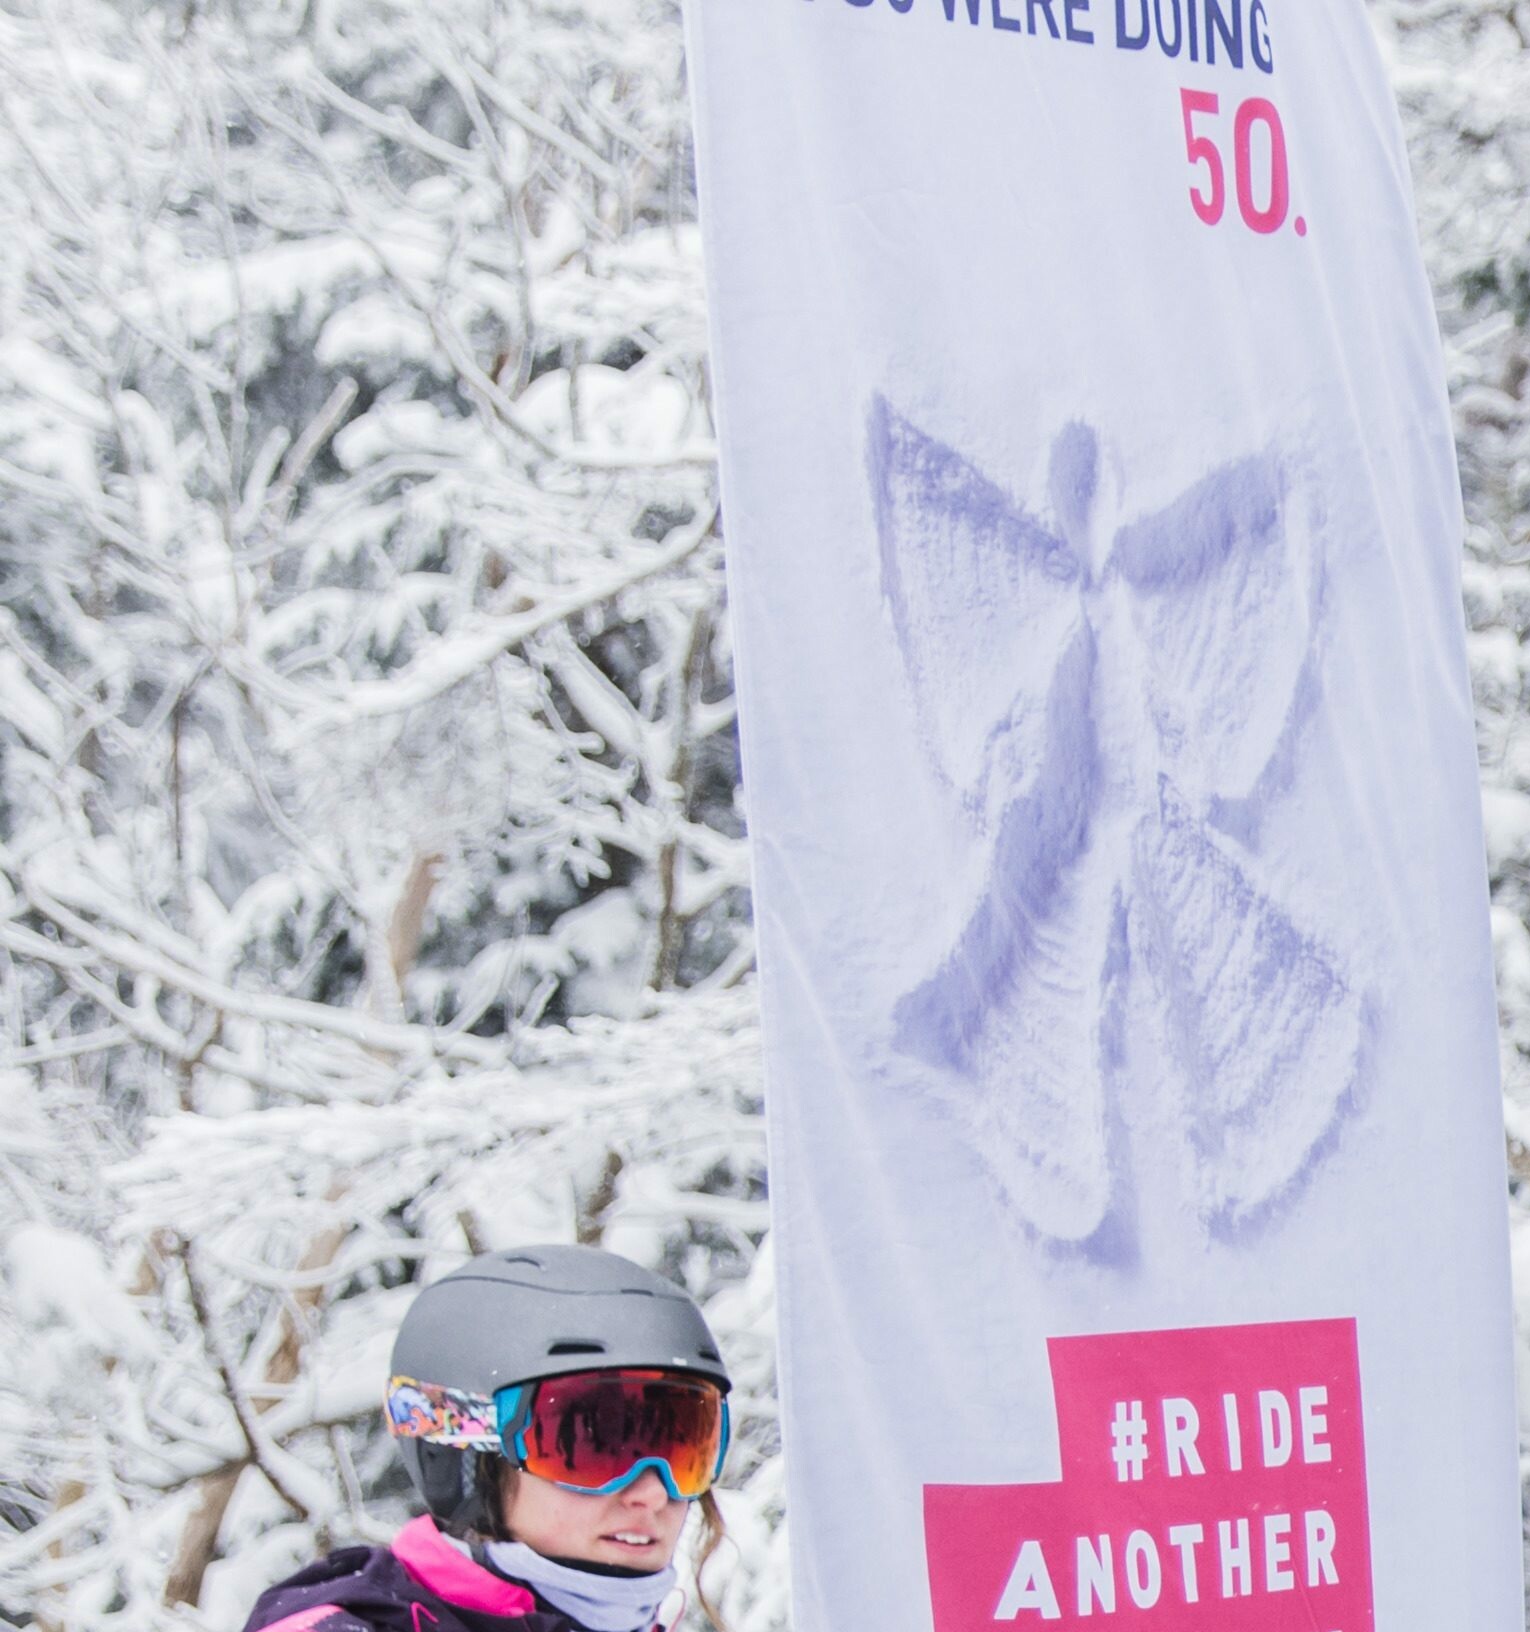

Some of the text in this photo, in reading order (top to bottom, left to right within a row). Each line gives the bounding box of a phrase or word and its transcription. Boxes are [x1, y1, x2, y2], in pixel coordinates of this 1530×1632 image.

[1116, 0, 1274, 74] DOING
[1180, 87, 1307, 237] 50.
[1111, 1386, 1332, 1481] #RIDE
[994, 1510, 1340, 1620] ANOTHER
